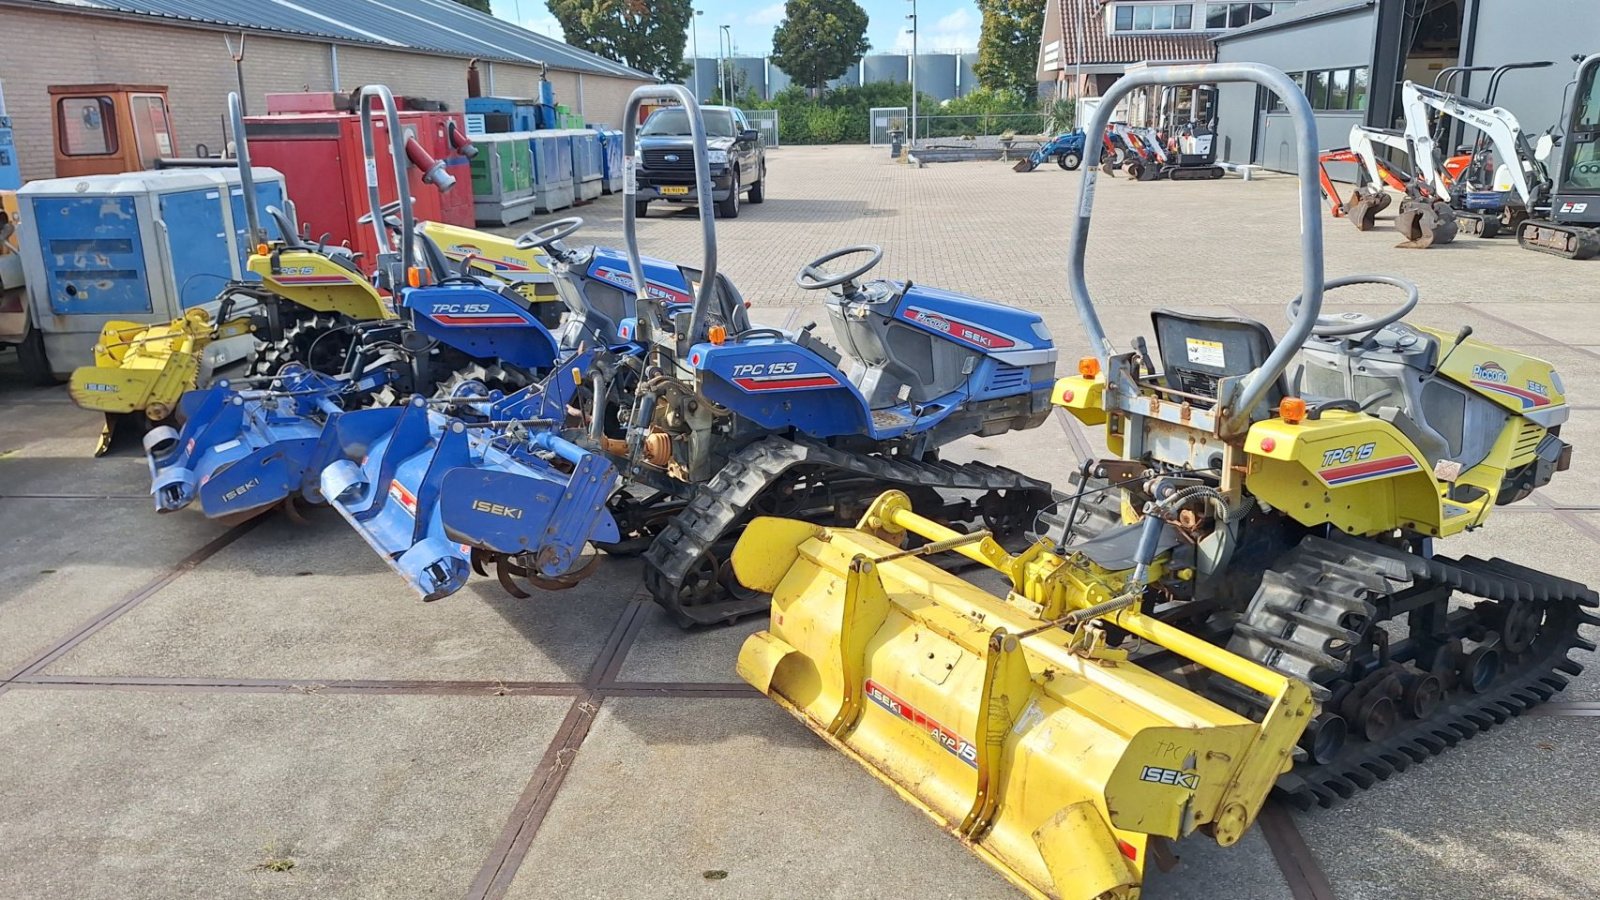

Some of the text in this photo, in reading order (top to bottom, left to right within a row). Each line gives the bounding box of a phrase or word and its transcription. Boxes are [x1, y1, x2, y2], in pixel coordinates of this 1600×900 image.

[648, 286, 677, 302] ISEKI
[432, 303, 491, 314] TPC 153
[917, 312, 951, 333] Piccoro
[961, 328, 992, 346] ISEKI
[732, 361, 798, 377] TPC 153
[1472, 365, 1508, 384] Piccoro
[1321, 442, 1377, 467] TPC 15
[221, 477, 260, 503] ISEKI
[472, 500, 523, 520] ISEKI
[870, 688, 902, 714] ISEKI
[1154, 740, 1183, 760] TPC
[1139, 765, 1201, 791] ISEKI
